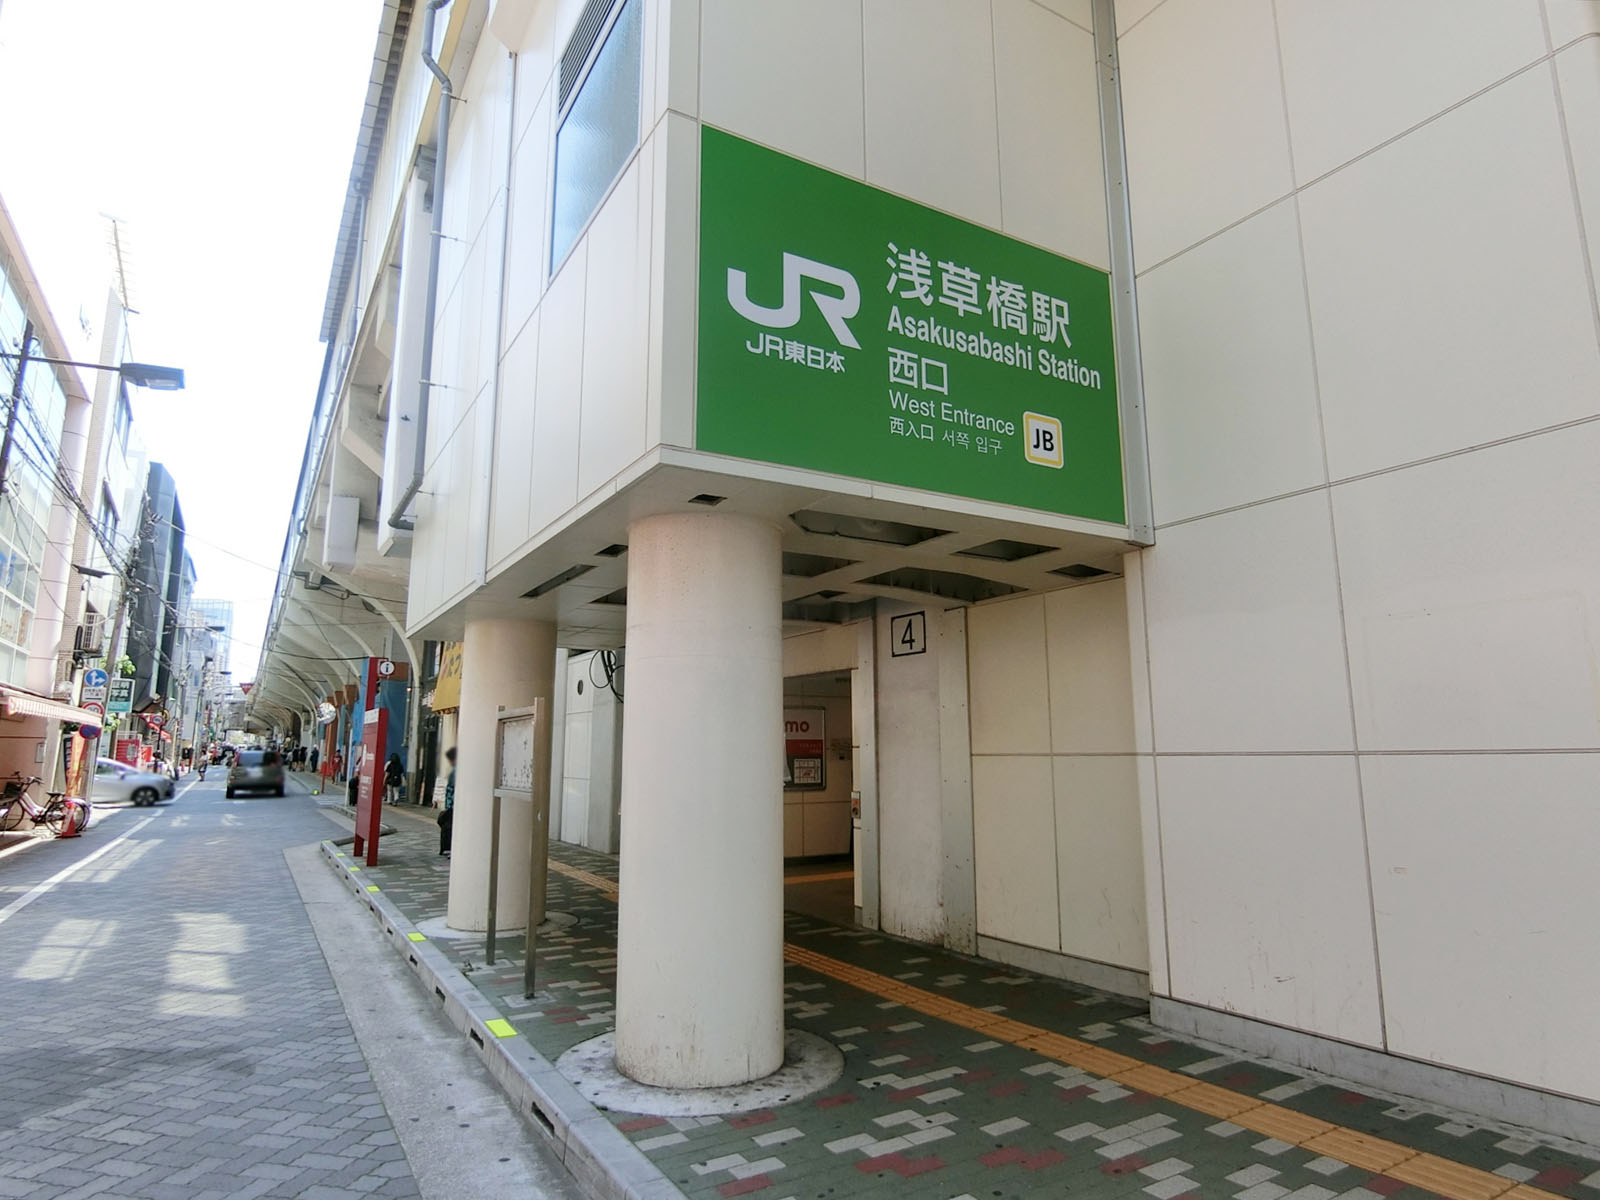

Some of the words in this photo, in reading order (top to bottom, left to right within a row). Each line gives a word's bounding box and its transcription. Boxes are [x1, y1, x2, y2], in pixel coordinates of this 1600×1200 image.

[727, 252, 862, 350] JR
[886, 241, 1072, 349] 浅草橋駅
[746, 333, 845, 373] JR東日本
[887, 305, 1033, 371] Asakusabashi
[1038, 348, 1101, 390] Station
[888, 346, 949, 396] 西口
[889, 389, 936, 418] West
[941, 402, 1015, 436] Entrance
[889, 416, 934, 441] 西入口
[942, 430, 970, 450] 서쪽
[975, 436, 1002, 456] 입구
[1033, 428, 1055, 452] JB
[901, 618, 915, 650] 4
